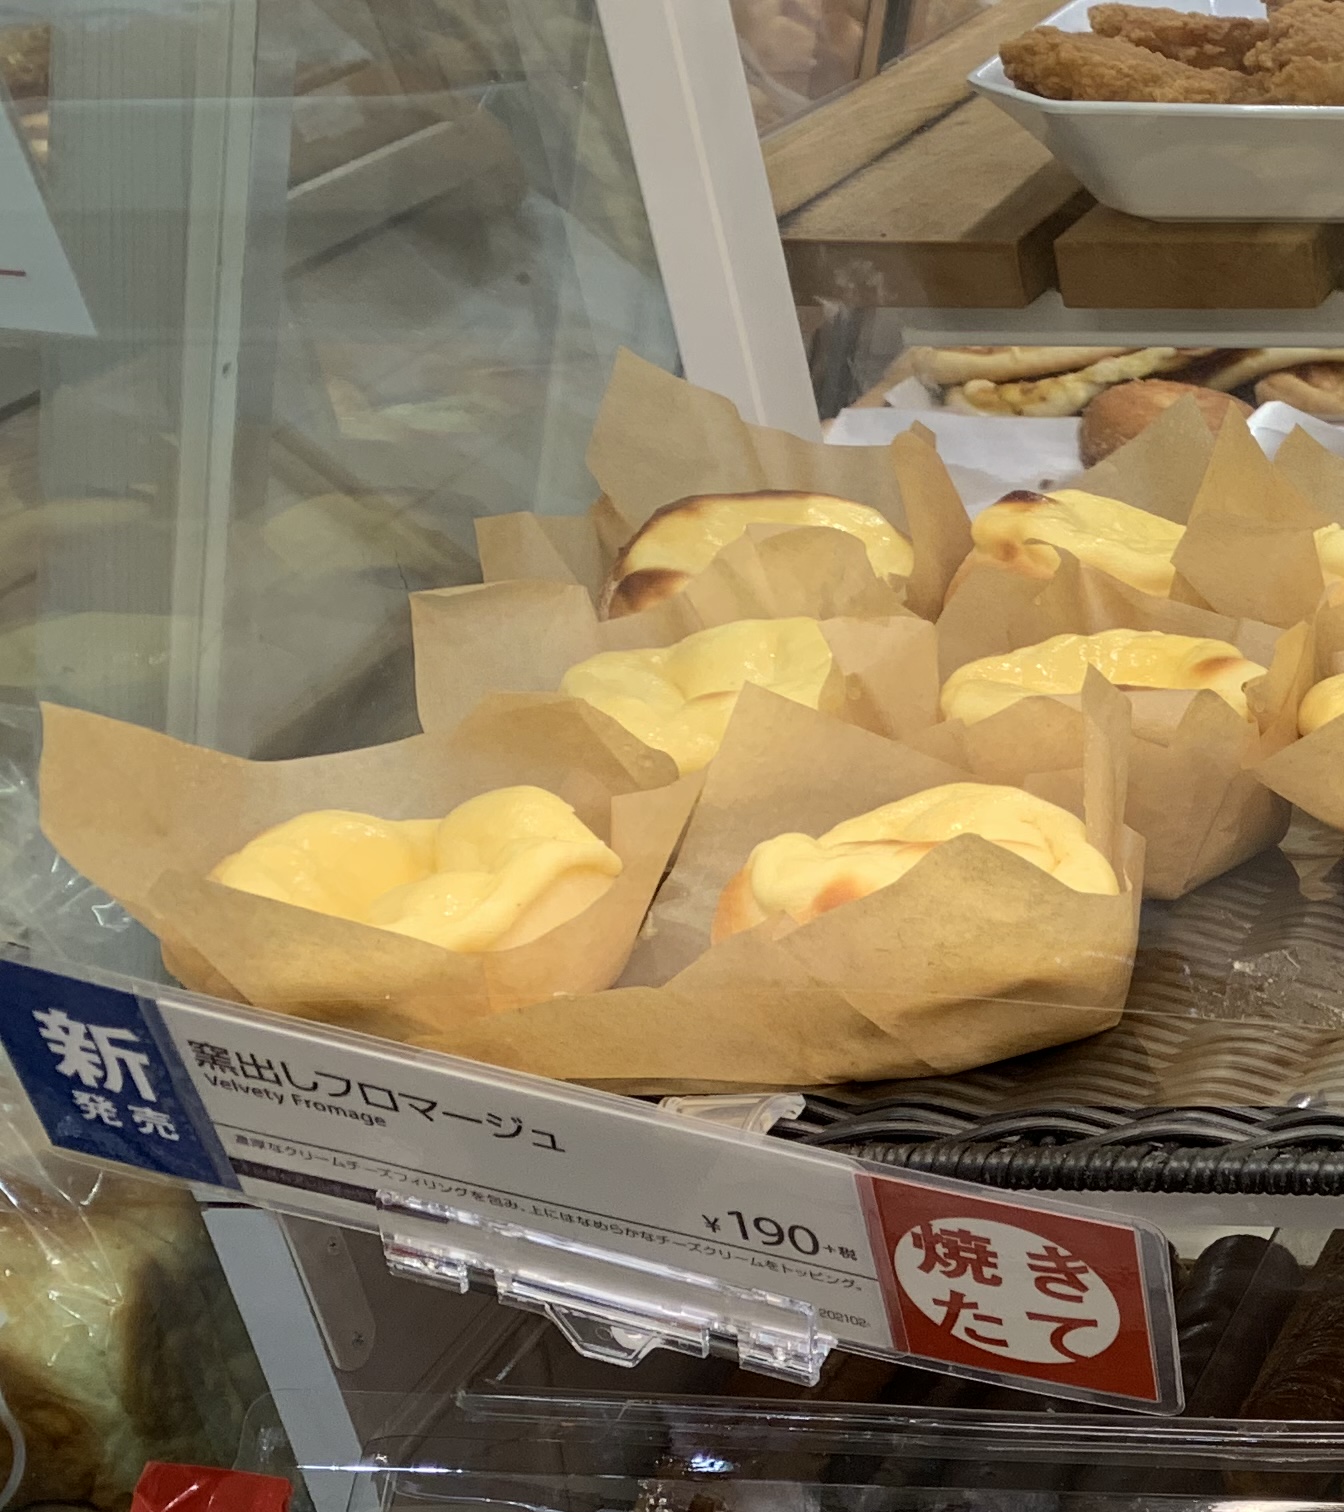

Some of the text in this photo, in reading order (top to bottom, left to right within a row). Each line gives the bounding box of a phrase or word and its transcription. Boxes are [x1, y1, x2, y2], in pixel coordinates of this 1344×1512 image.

[32, 1007, 157, 1102] 新
[71, 1089, 181, 1142] 発売
[187, 1039, 568, 1154] 窯出しフロマージュ
[204, 1072, 388, 1129] Velvety Fromage
[911, 1223, 1091, 1304] 焼き
[931, 1289, 1099, 1360] たて
